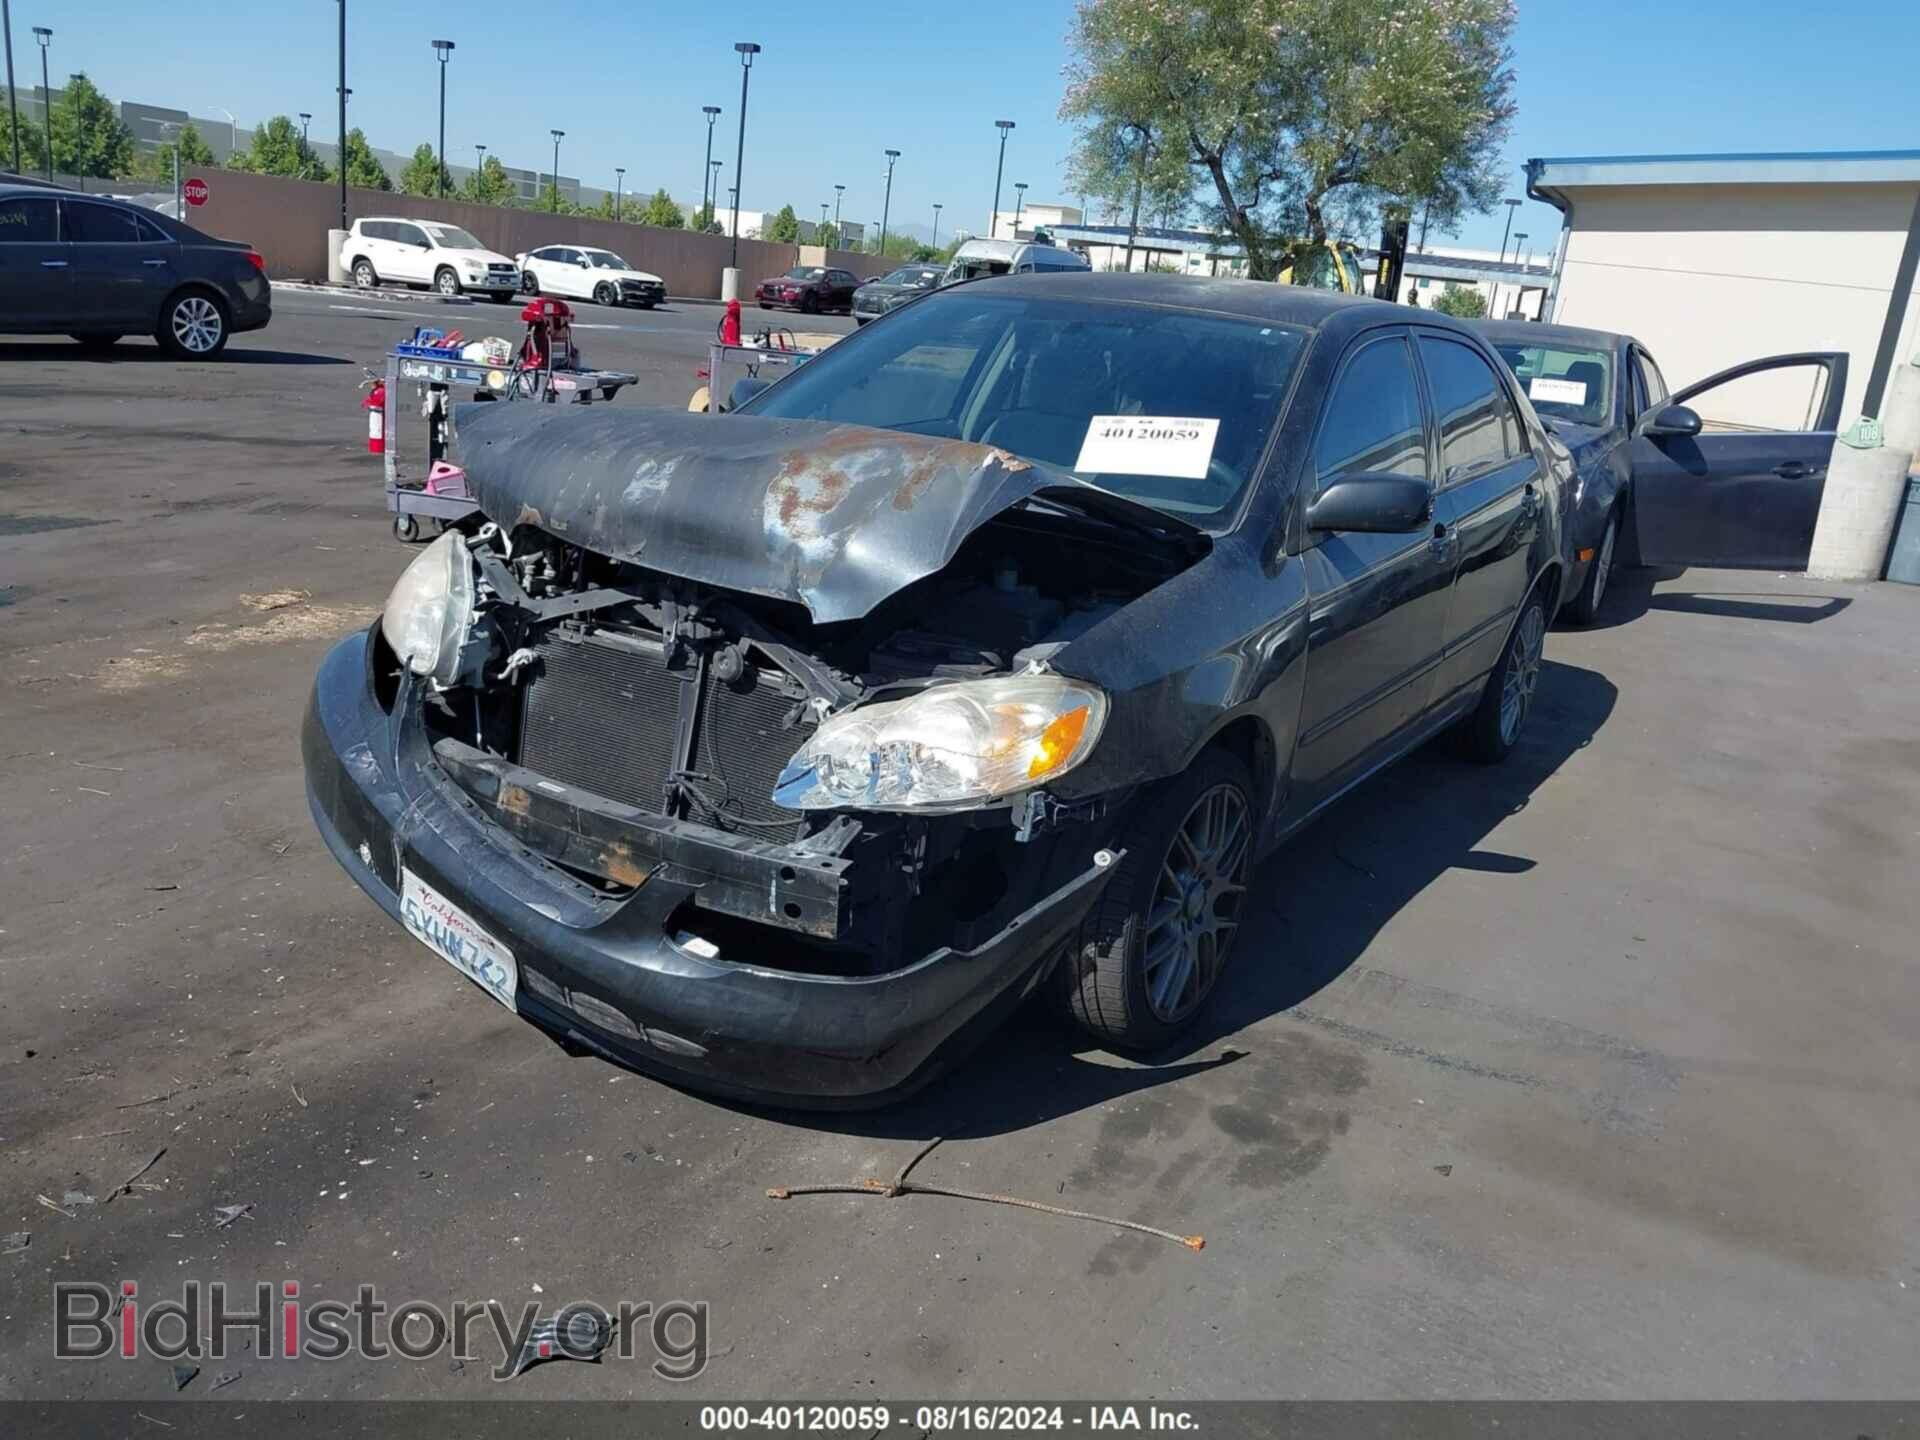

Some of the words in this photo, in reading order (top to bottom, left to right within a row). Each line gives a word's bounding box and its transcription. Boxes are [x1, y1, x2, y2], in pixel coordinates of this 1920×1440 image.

[185, 186, 208, 198] STOP
[1099, 427, 1200, 441] 40120059
[421, 891, 490, 946] California
